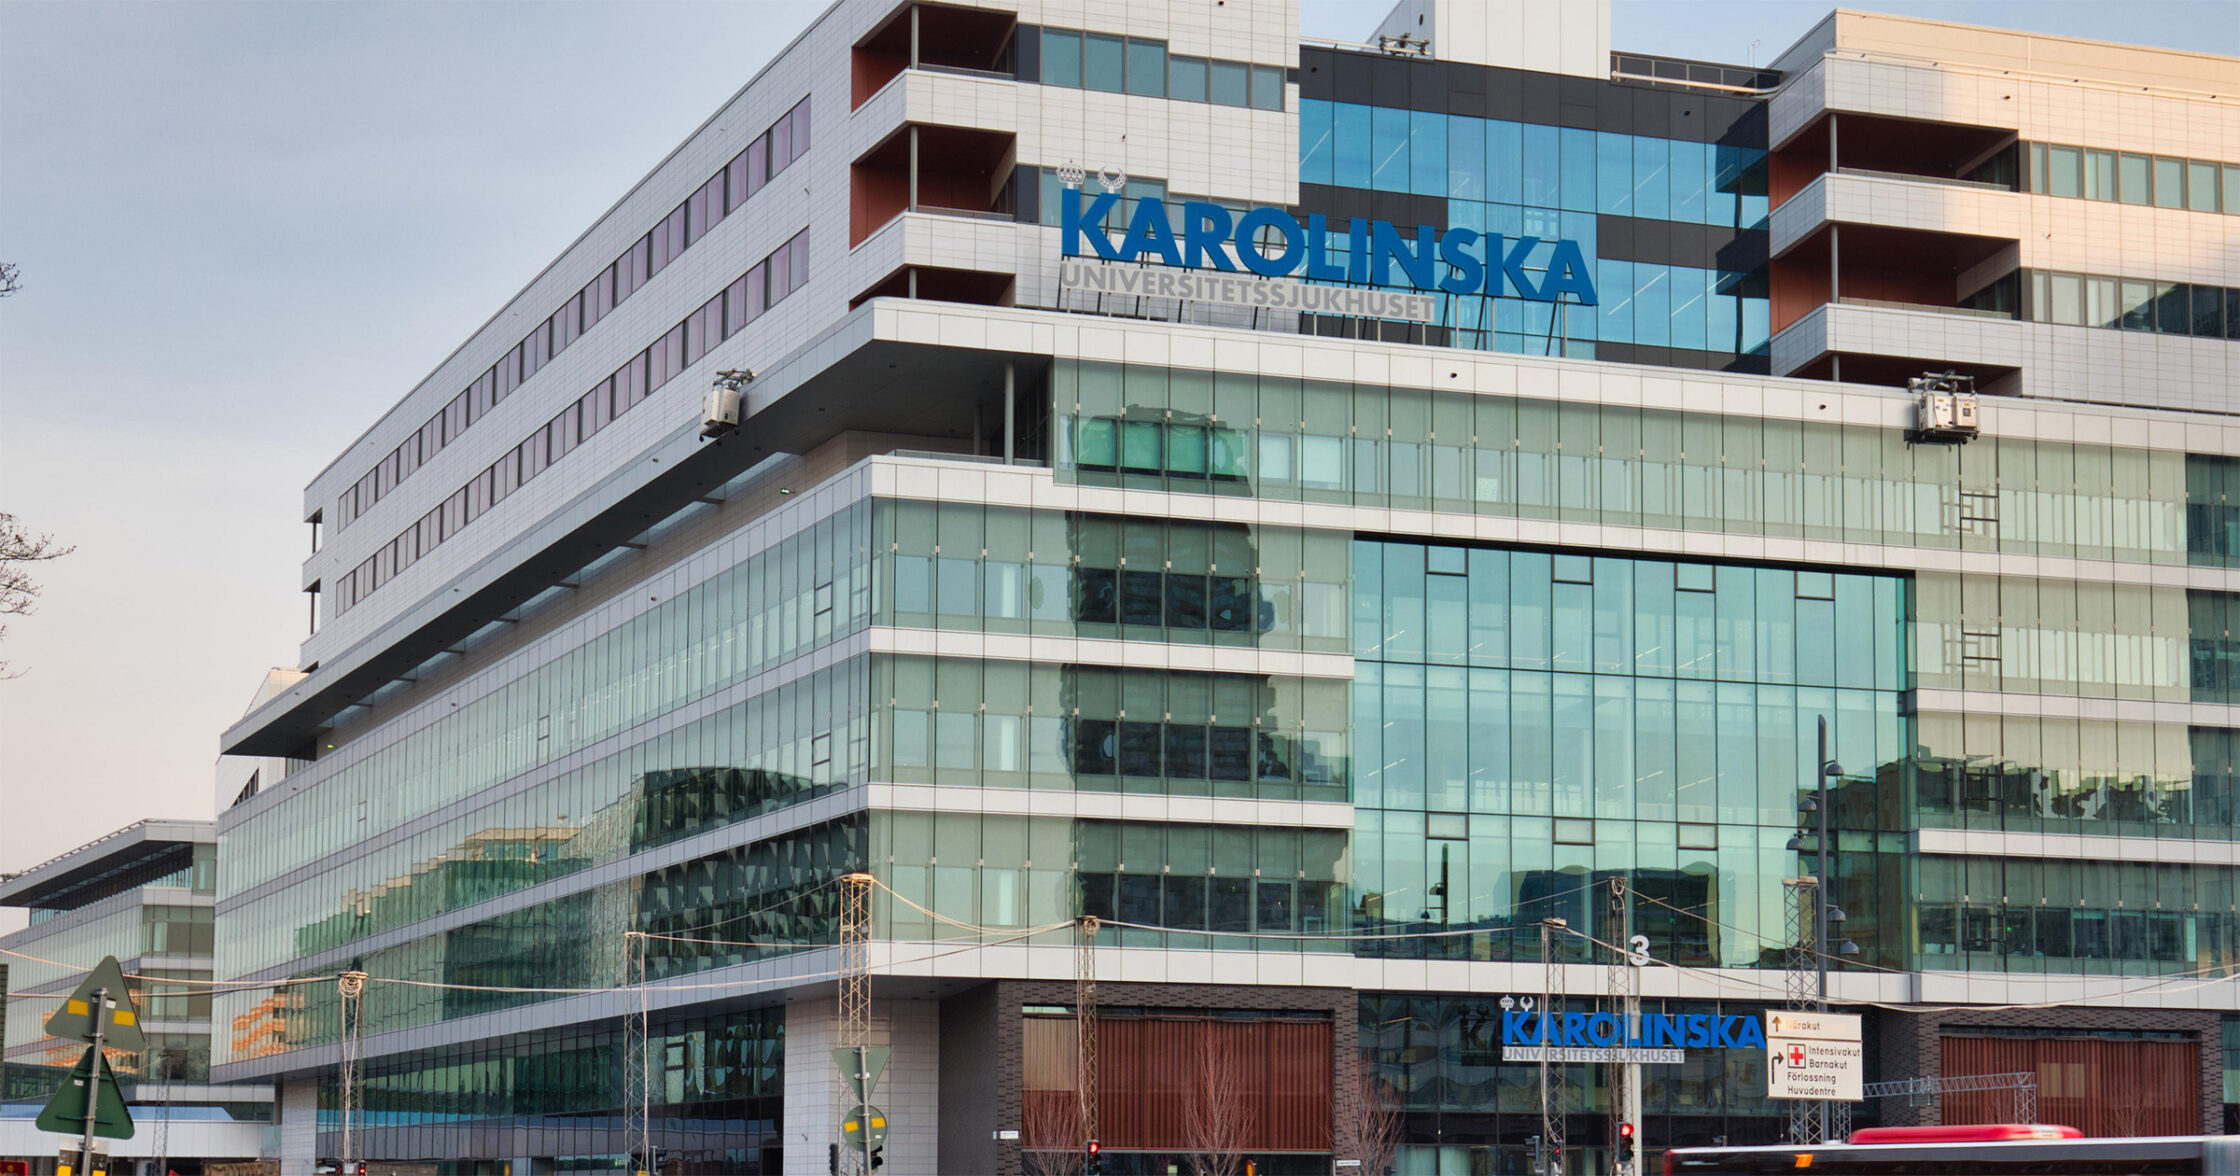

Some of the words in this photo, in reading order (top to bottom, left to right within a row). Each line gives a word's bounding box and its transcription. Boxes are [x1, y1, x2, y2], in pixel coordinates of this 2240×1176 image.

[1061, 188, 1598, 306] KAROLINSKA
[1061, 262, 1434, 321] UNIVERSITETSSJUKHUSET
[1629, 935, 1650, 966] 3
[1503, 1010, 1766, 1049] KAROLINSKA
[1809, 1045, 1861, 1057] Intensivakut
[1809, 1059, 1848, 1070] Barnakut
[1787, 1071, 1836, 1084] Förlossning
